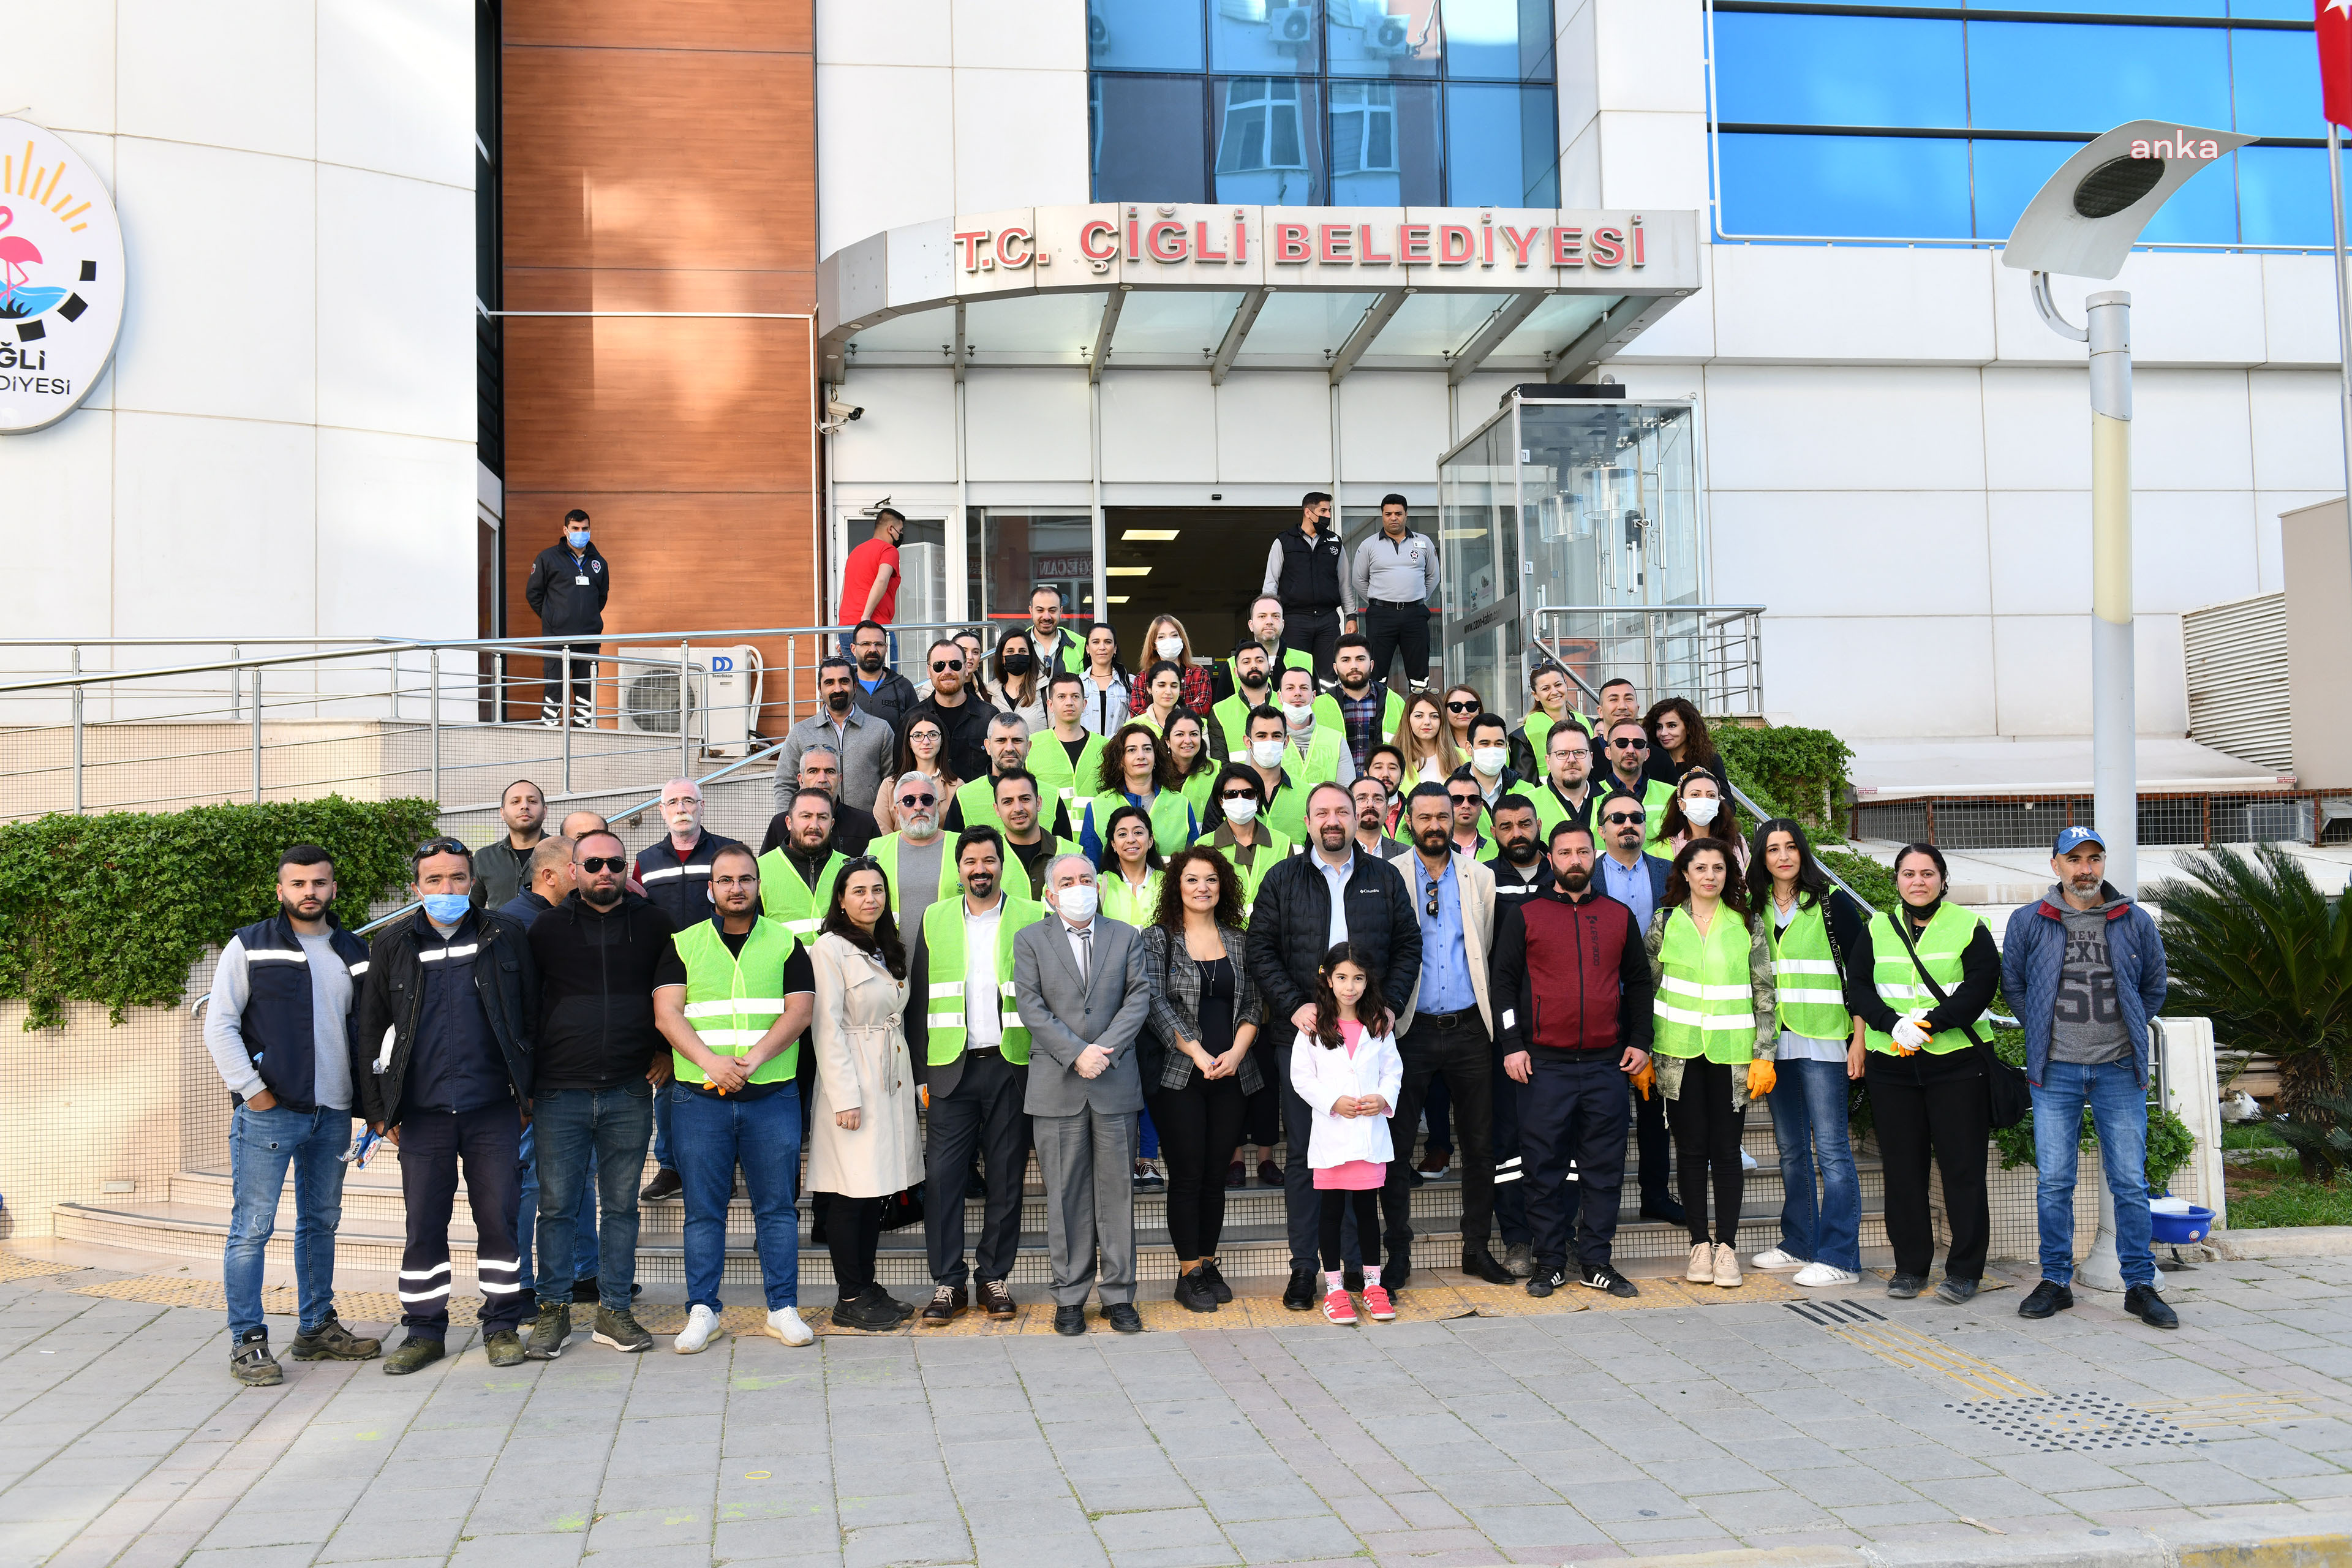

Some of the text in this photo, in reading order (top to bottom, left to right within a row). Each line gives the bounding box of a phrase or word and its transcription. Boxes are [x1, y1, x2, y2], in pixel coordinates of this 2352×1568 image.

[952, 205, 1646, 274] T.C. ÇİĞLİ BELEDİYESİ
[0, 341, 45, 371] ĞLİ
[0, 375, 70, 395] DİYESİ
[2068, 931, 2097, 941] NEW
